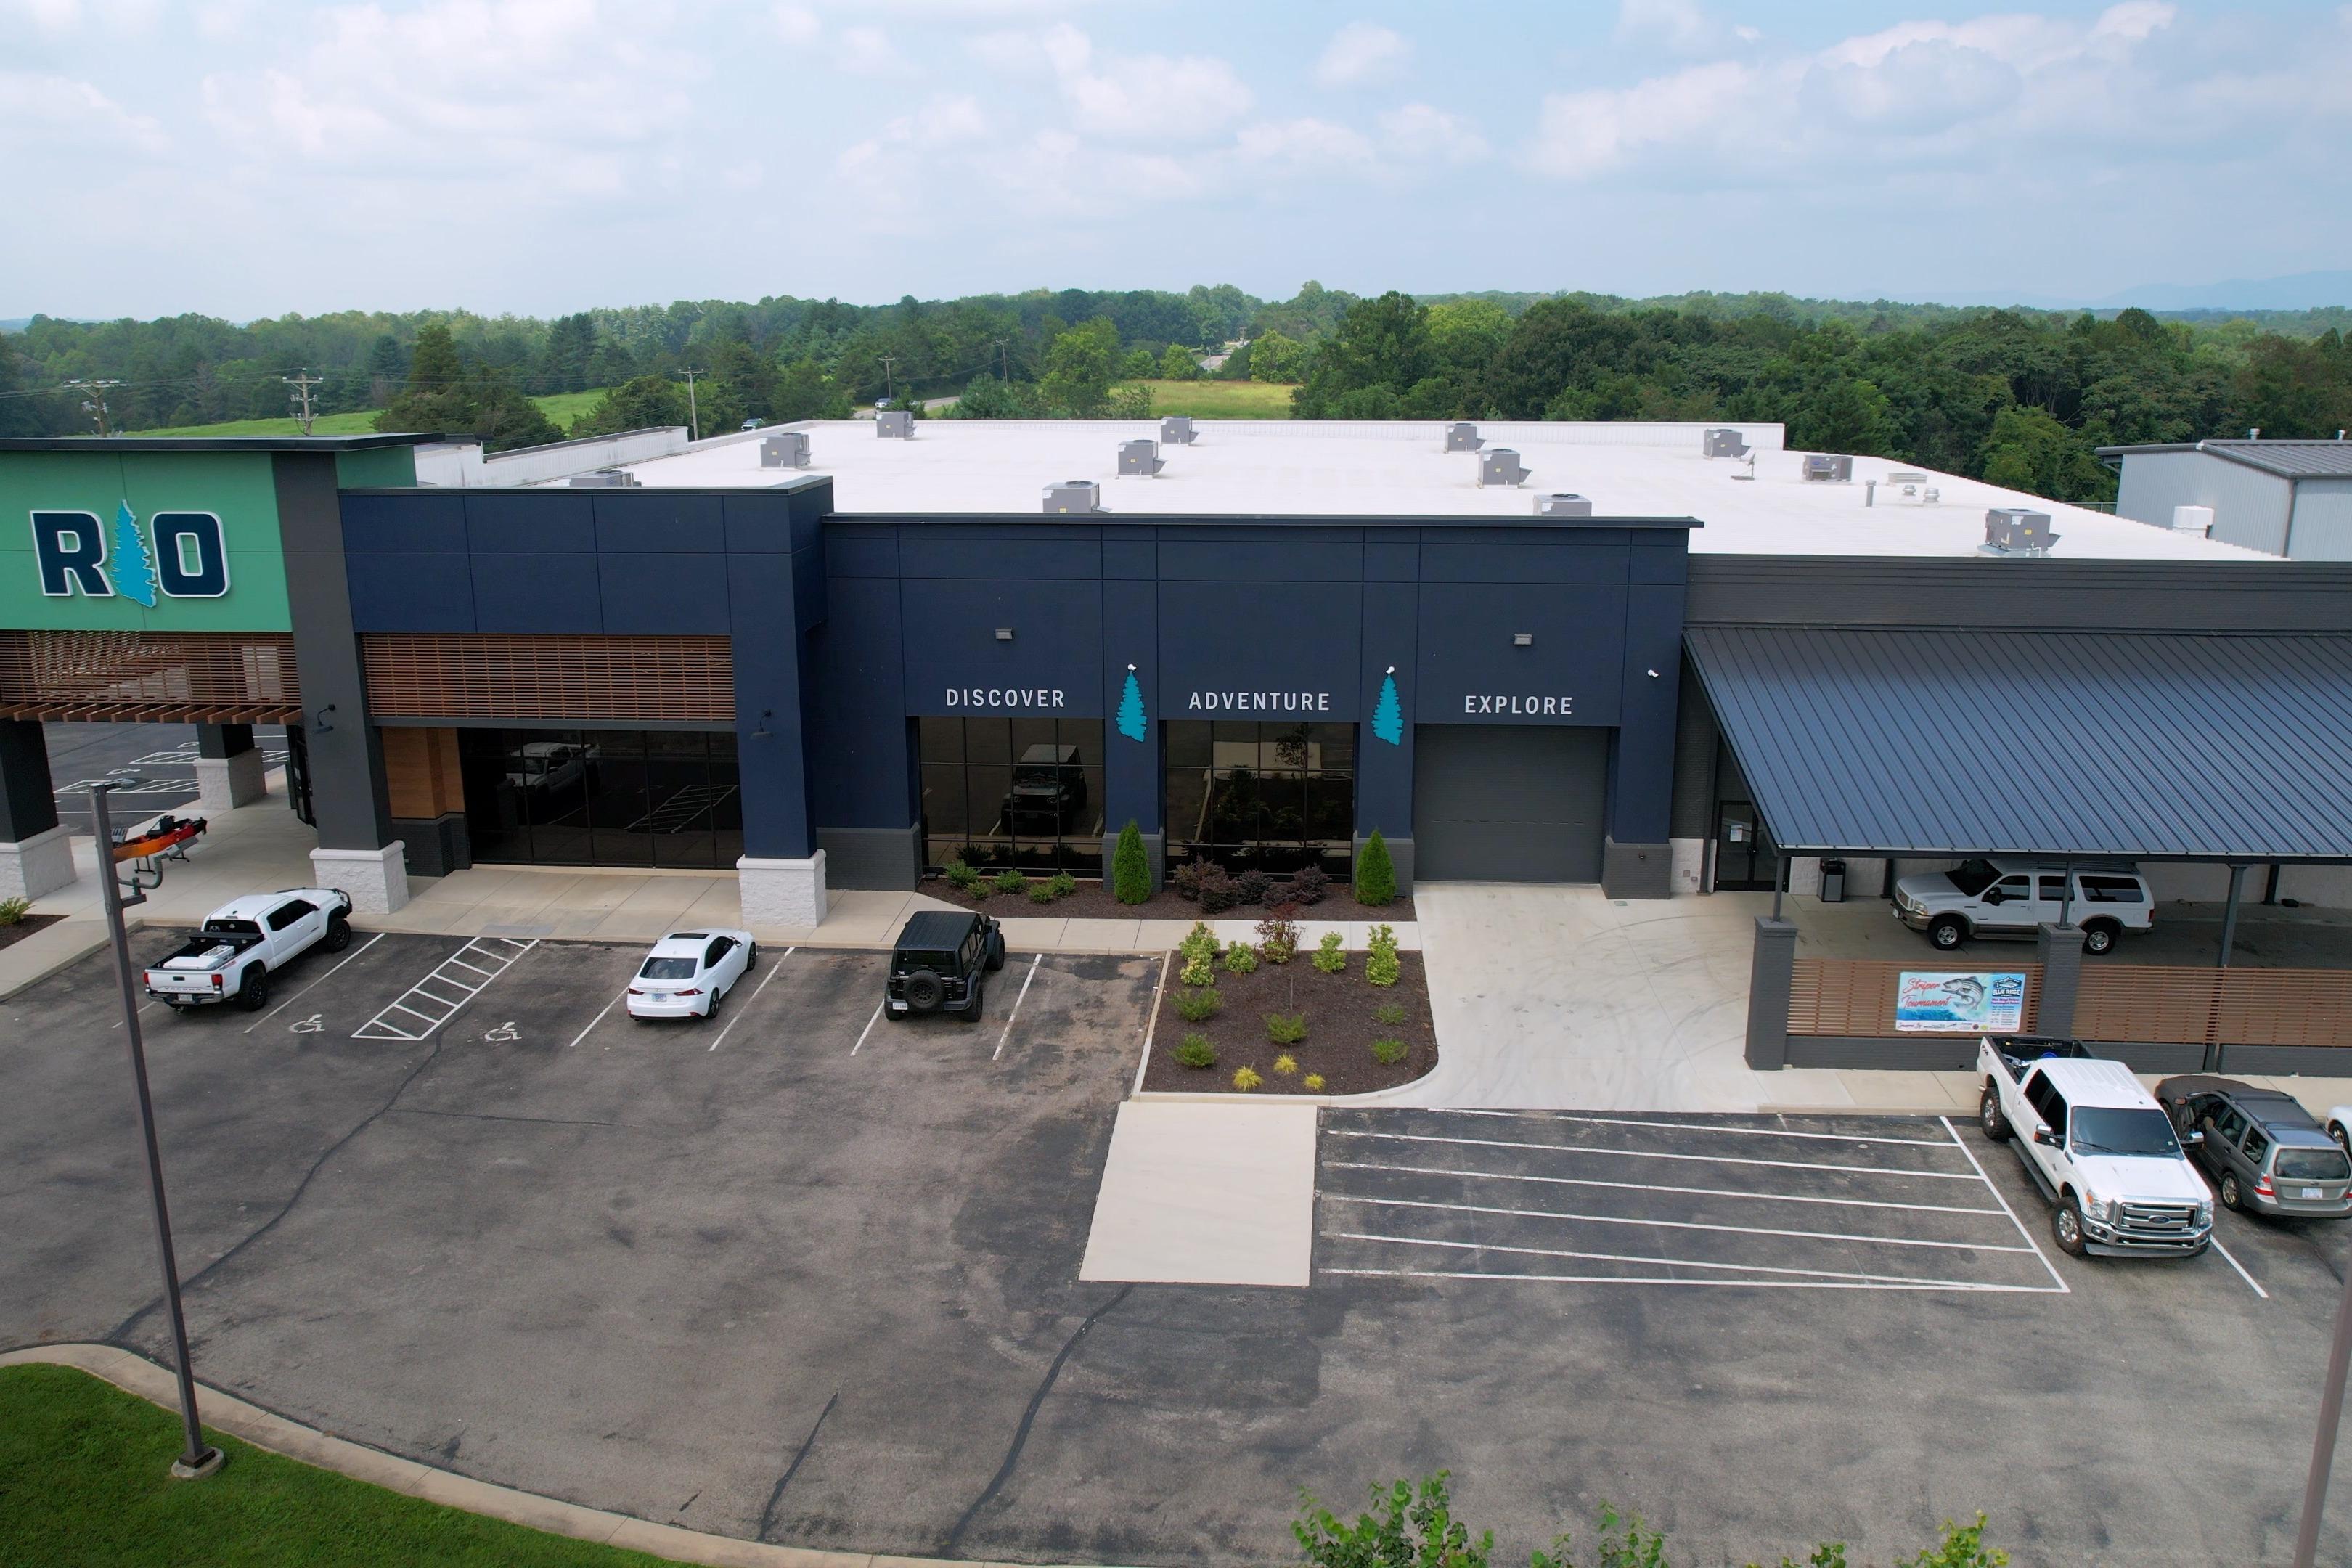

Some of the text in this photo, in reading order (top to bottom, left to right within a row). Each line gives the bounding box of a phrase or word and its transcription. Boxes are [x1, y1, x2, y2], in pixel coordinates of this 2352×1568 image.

[946, 688, 1065, 708] DISCOVER
[1188, 691, 1331, 711] ADVENTURE
[1464, 695, 1573, 716] EXPLORE
[1903, 978, 1942, 998] Striper
[1901, 995, 1954, 1009] Tournament
